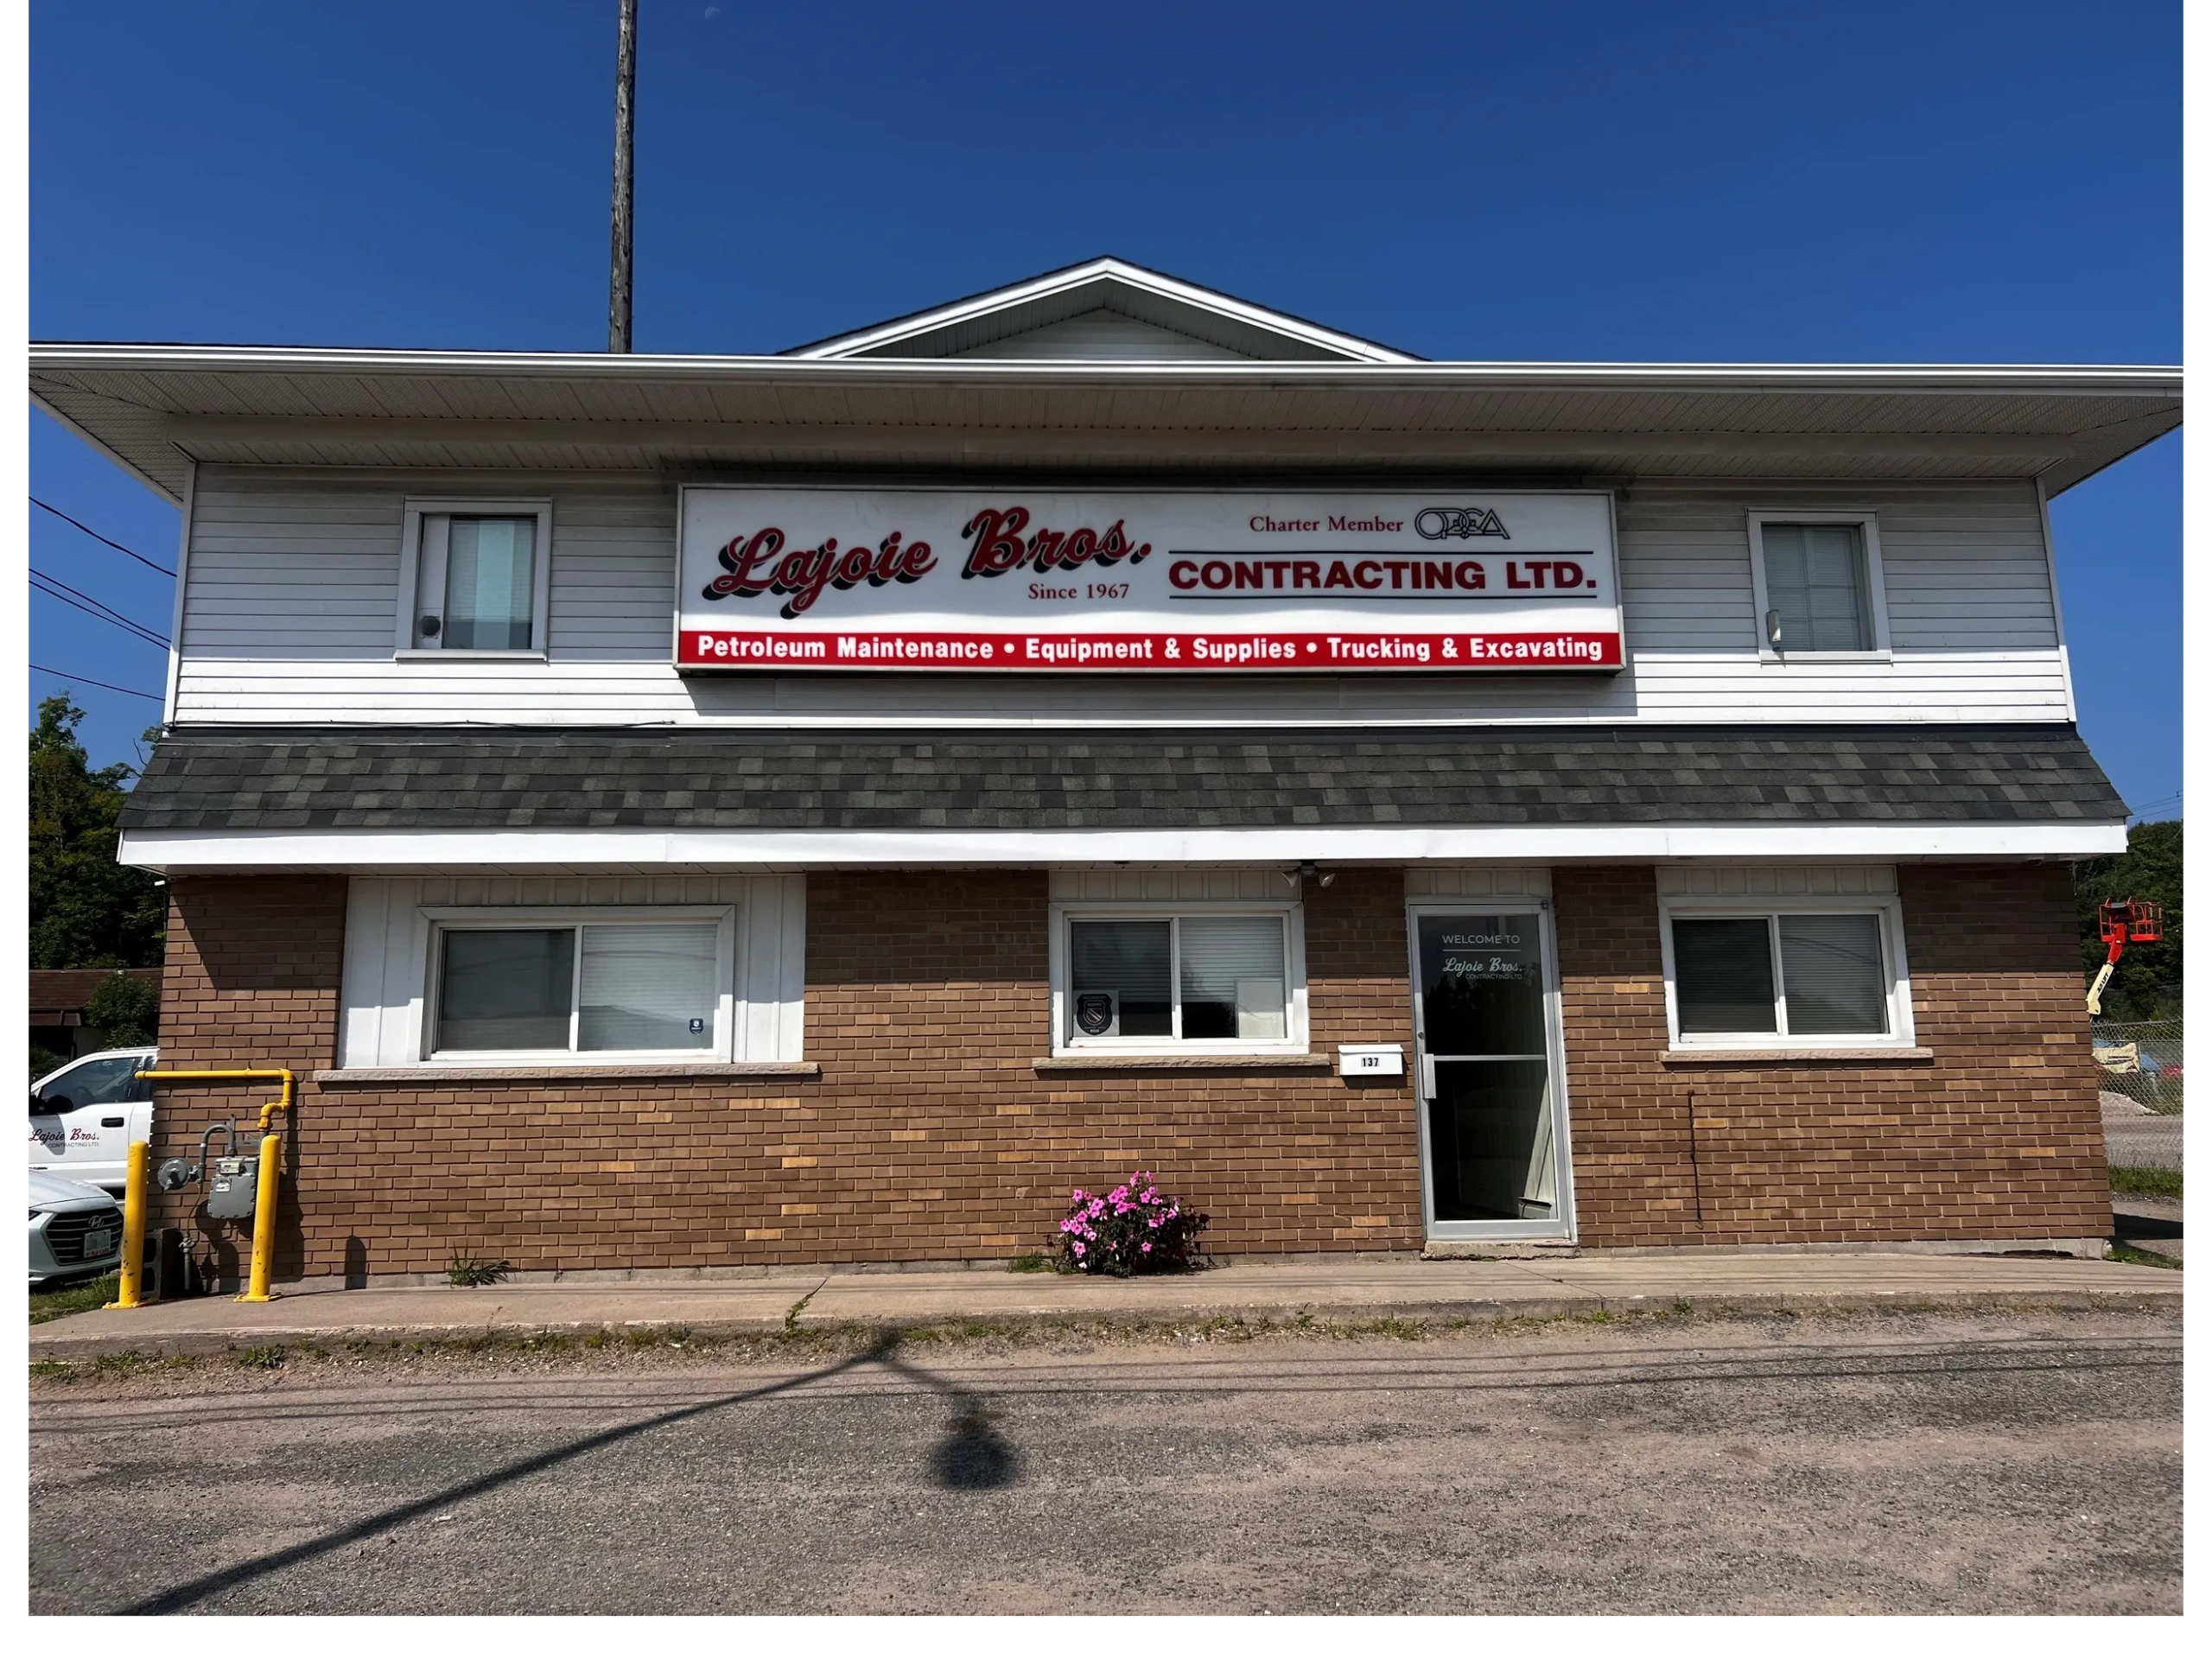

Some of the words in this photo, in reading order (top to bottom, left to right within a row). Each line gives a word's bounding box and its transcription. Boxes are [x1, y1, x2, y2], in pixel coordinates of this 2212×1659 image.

[1249, 516, 1320, 532] Charter
[1327, 516, 1403, 532] Member
[702, 526, 939, 620] Lajoie
[961, 506, 1153, 581] Bros.
[1168, 560, 1486, 590] CONTRACTING
[1506, 561, 1597, 588] LTD.
[1028, 583, 1077, 600] Since
[1086, 583, 1129, 600] 1967
[697, 636, 826, 658] Petroleum
[837, 637, 994, 659] Maintenance
[1026, 639, 1153, 662] Equipment
[1164, 639, 1181, 659] &
[1192, 639, 1297, 663] Supplies
[1327, 638, 1431, 662] Trucking
[1441, 638, 1459, 658] &
[1470, 637, 1603, 661] Excavating
[1442, 935, 1502, 944] WELCOME
[1504, 935, 1520, 944] TO
[1442, 957, 1484, 977] Lajoie
[1489, 957, 1522, 972] Bros.
[1362, 1057, 1379, 1067] 137
[28, 1128, 66, 1146] Lajoie
[70, 1128, 99, 1141] Bros.
